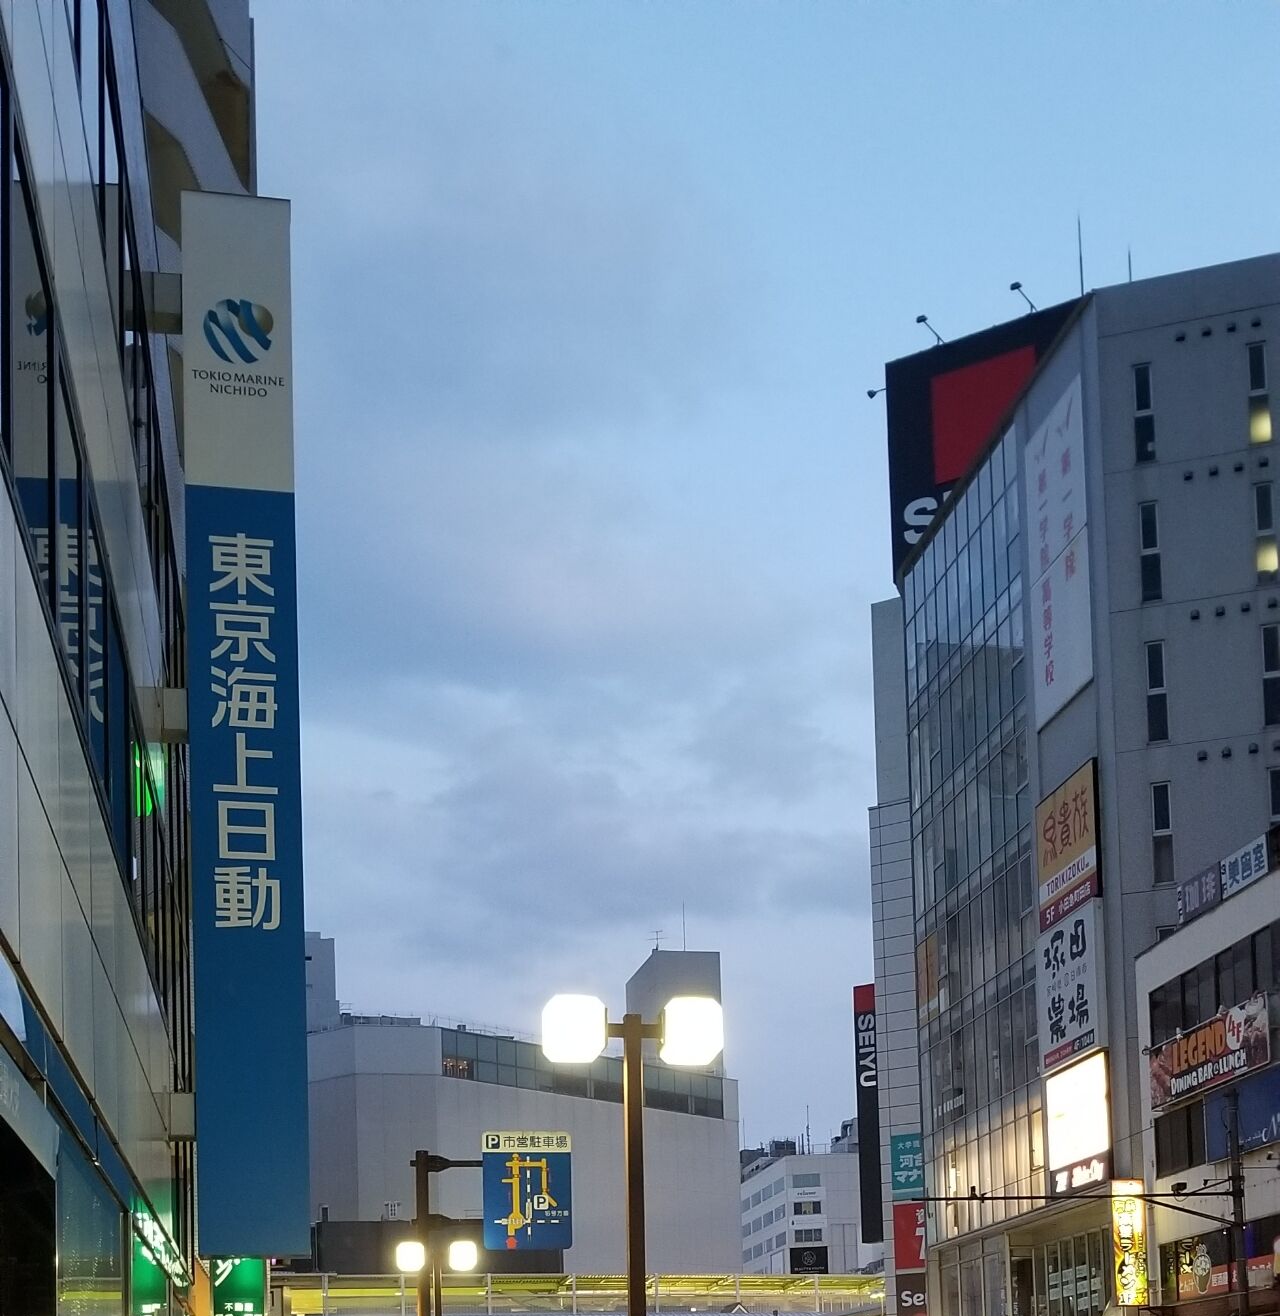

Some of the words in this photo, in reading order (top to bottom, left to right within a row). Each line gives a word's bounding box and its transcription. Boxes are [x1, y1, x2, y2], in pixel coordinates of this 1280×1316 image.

[192, 369, 231, 381] TOKIO
[234, 373, 285, 387] MARINE
[210, 383, 268, 397] NICHIDO
[208, 532, 281, 931] 東京海上日動
[1046, 856, 1086, 898] TORIKIZOKU
[1044, 919, 1087, 980] 塚田
[1048, 984, 1090, 1044] 農場
[1228, 1014, 1241, 1043] 4F
[858, 1013, 877, 1087] SEIYU
[1171, 1020, 1226, 1076] LEGEND
[1170, 1071, 1198, 1096] DINING
[1198, 1062, 1214, 1084] BAR
[1219, 1049, 1247, 1075] LUNCH
[503, 1135, 568, 1148] 市営駐車場
[894, 1170, 921, 1183] マナ
